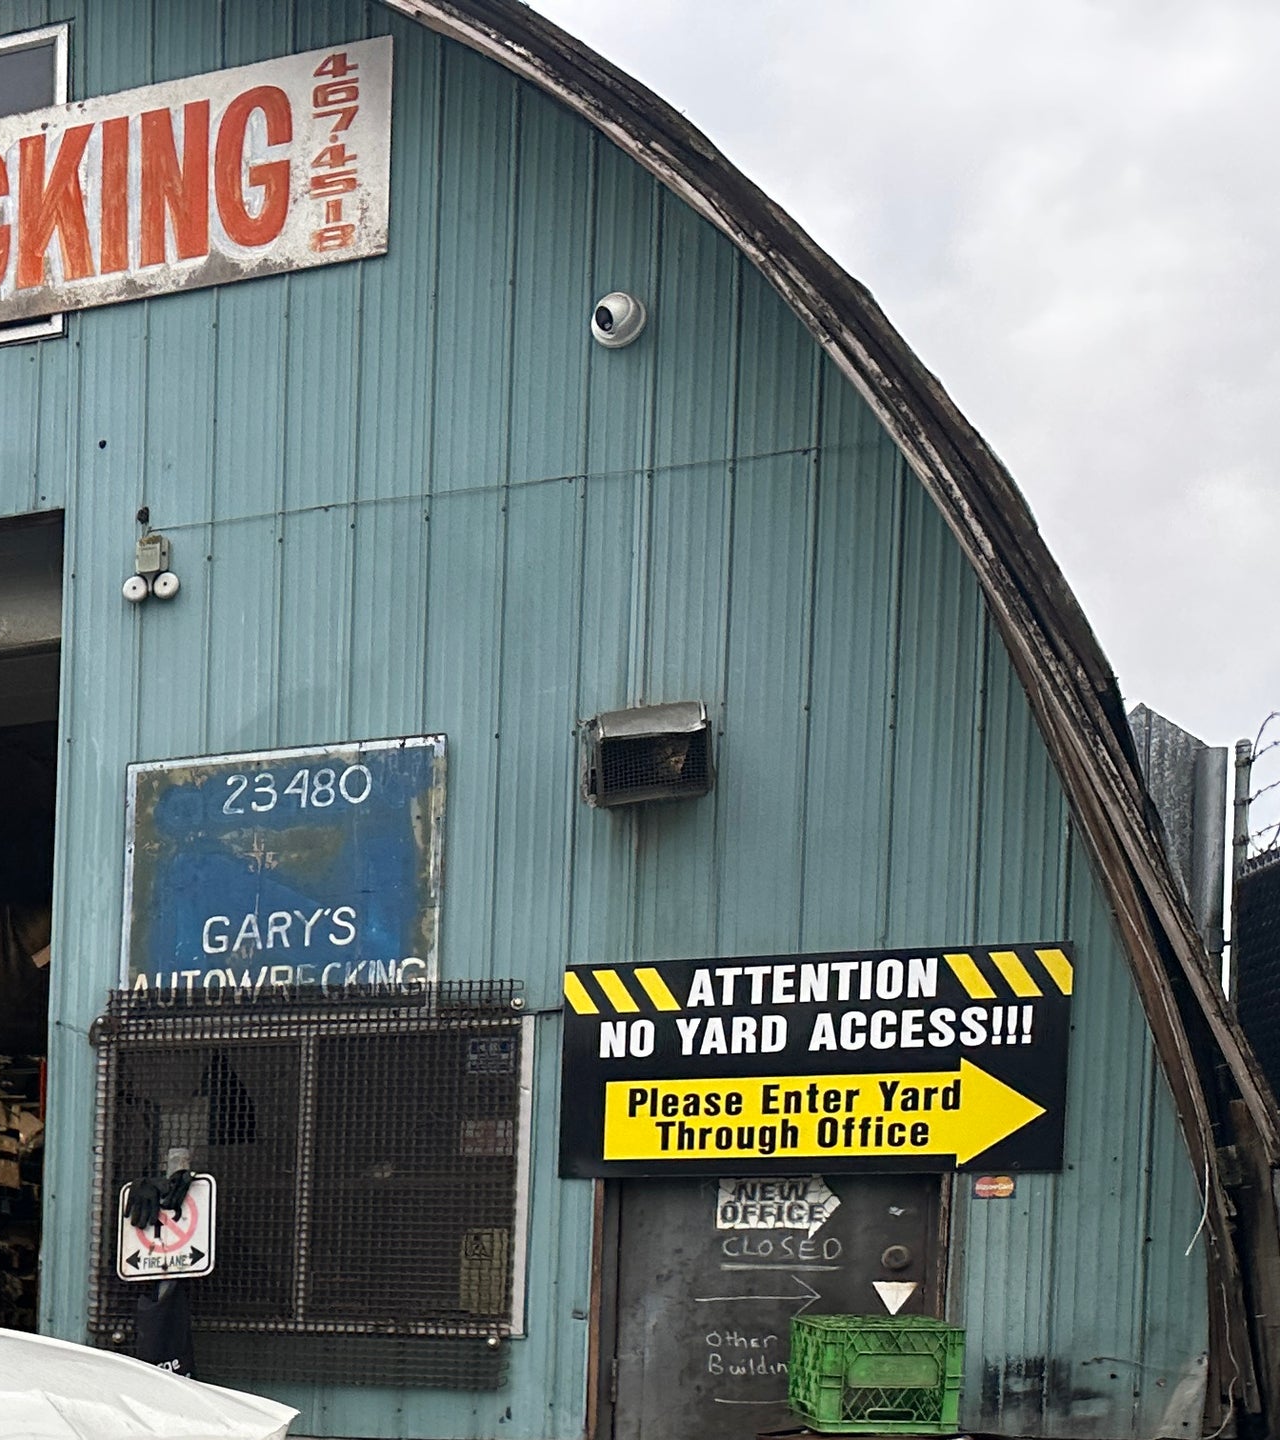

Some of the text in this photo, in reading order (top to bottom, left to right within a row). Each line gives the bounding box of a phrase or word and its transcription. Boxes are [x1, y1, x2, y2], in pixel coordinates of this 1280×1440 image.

[222, 763, 372, 815] 23480
[202, 905, 357, 955] GARY'S
[686, 958, 938, 1009] ATTENTION
[598, 1004, 1034, 1059] NO YARD ACCESS!!!
[628, 1078, 962, 1118] Please Enter Yard
[655, 1116, 930, 1156] Through Office
[736, 1181, 808, 1201] NEW
[720, 1201, 826, 1224] OFFICE
[143, 1256, 161, 1270] FIRE
[721, 1235, 842, 1260] CLOSED
[708, 1352, 790, 1376] Buildin
